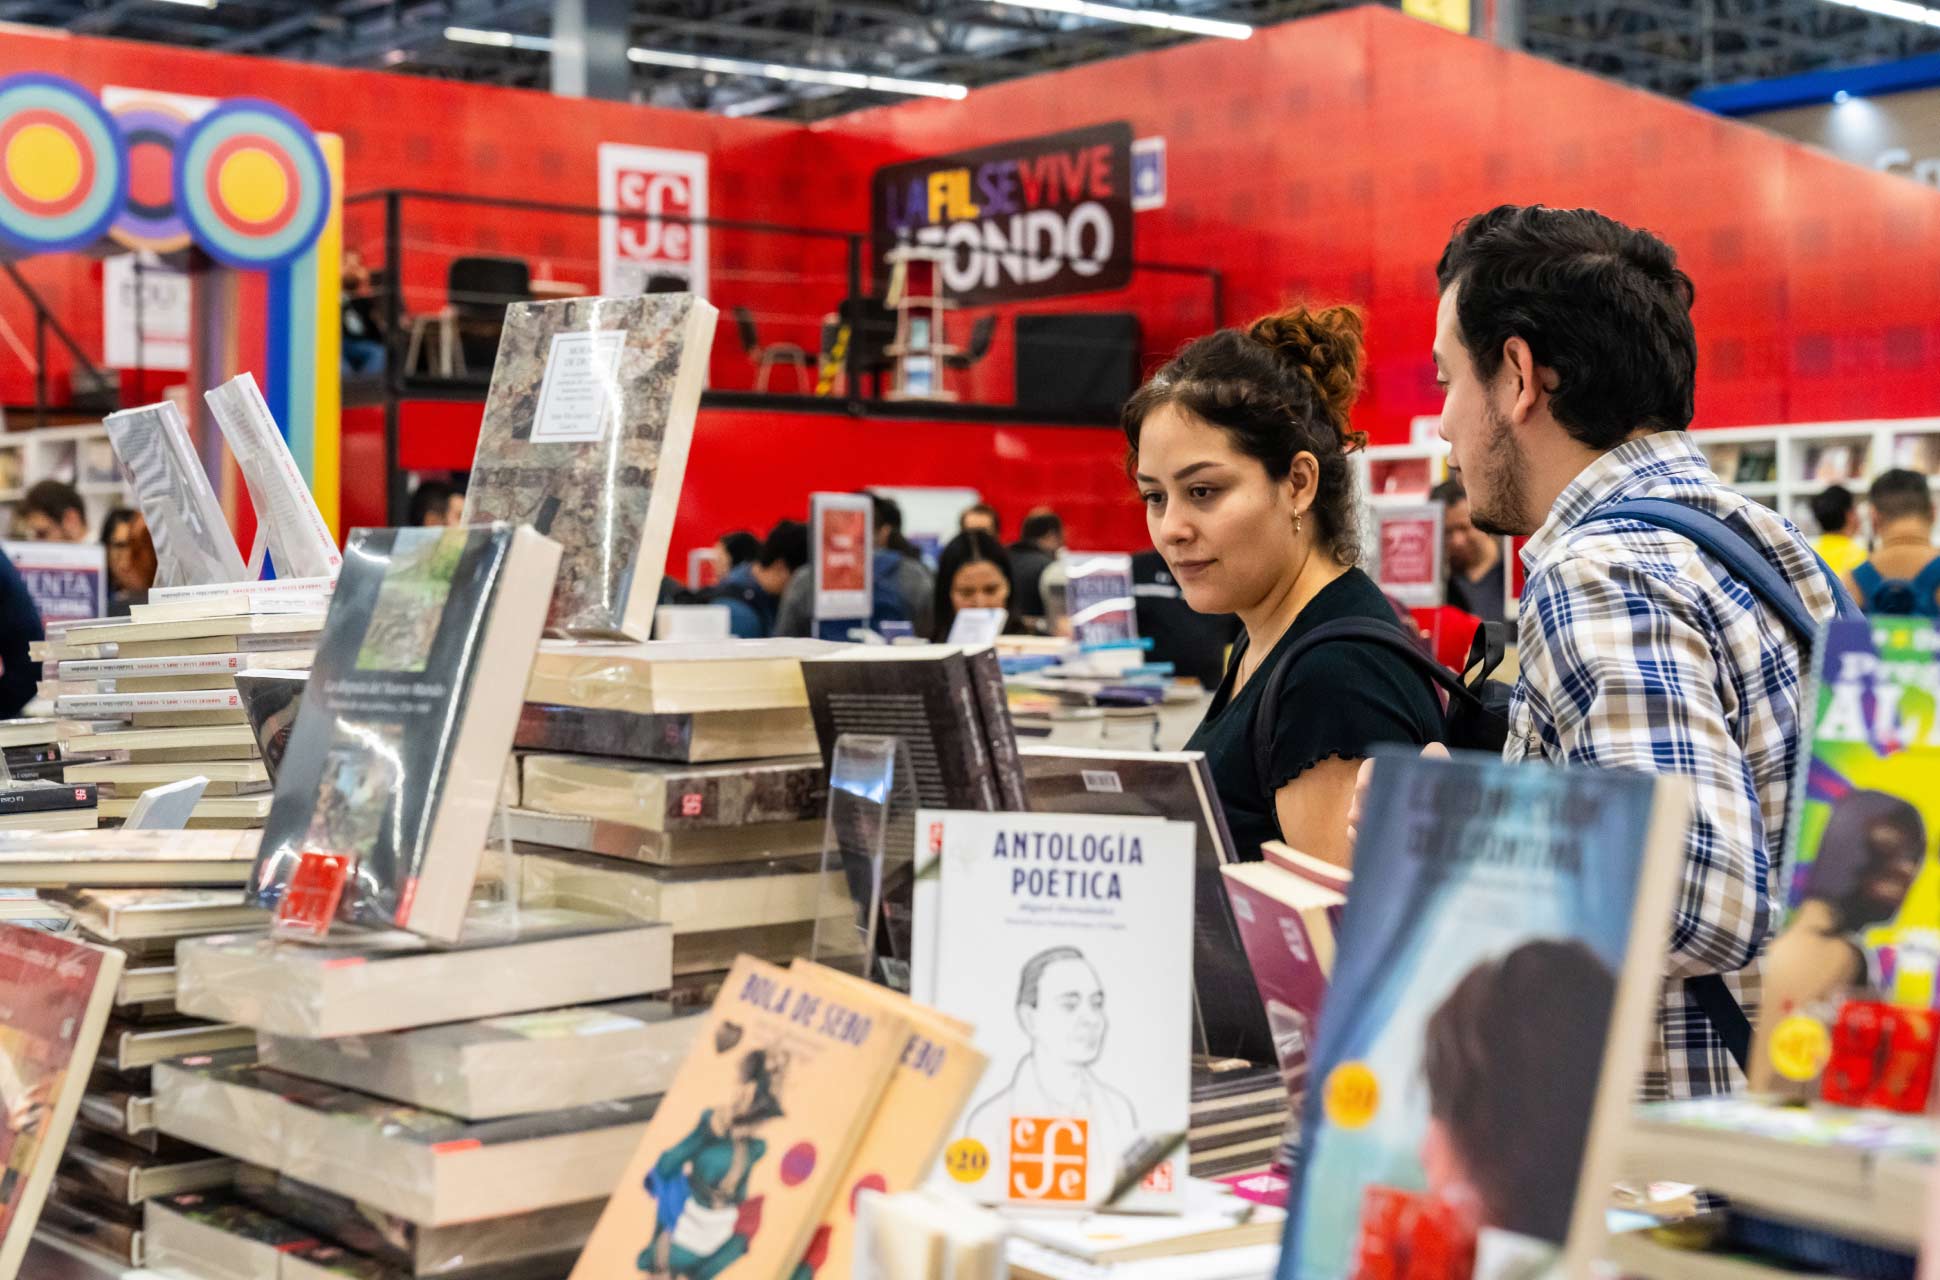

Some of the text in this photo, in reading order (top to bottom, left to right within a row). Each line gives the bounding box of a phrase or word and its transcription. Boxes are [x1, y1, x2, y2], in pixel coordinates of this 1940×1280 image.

[927, 167, 980, 224] FIL
[1017, 144, 1113, 206] VIVE
[739, 973, 791, 1014] BOLA
[791, 992, 821, 1028] DE
[818, 1003, 873, 1046] SEBO
